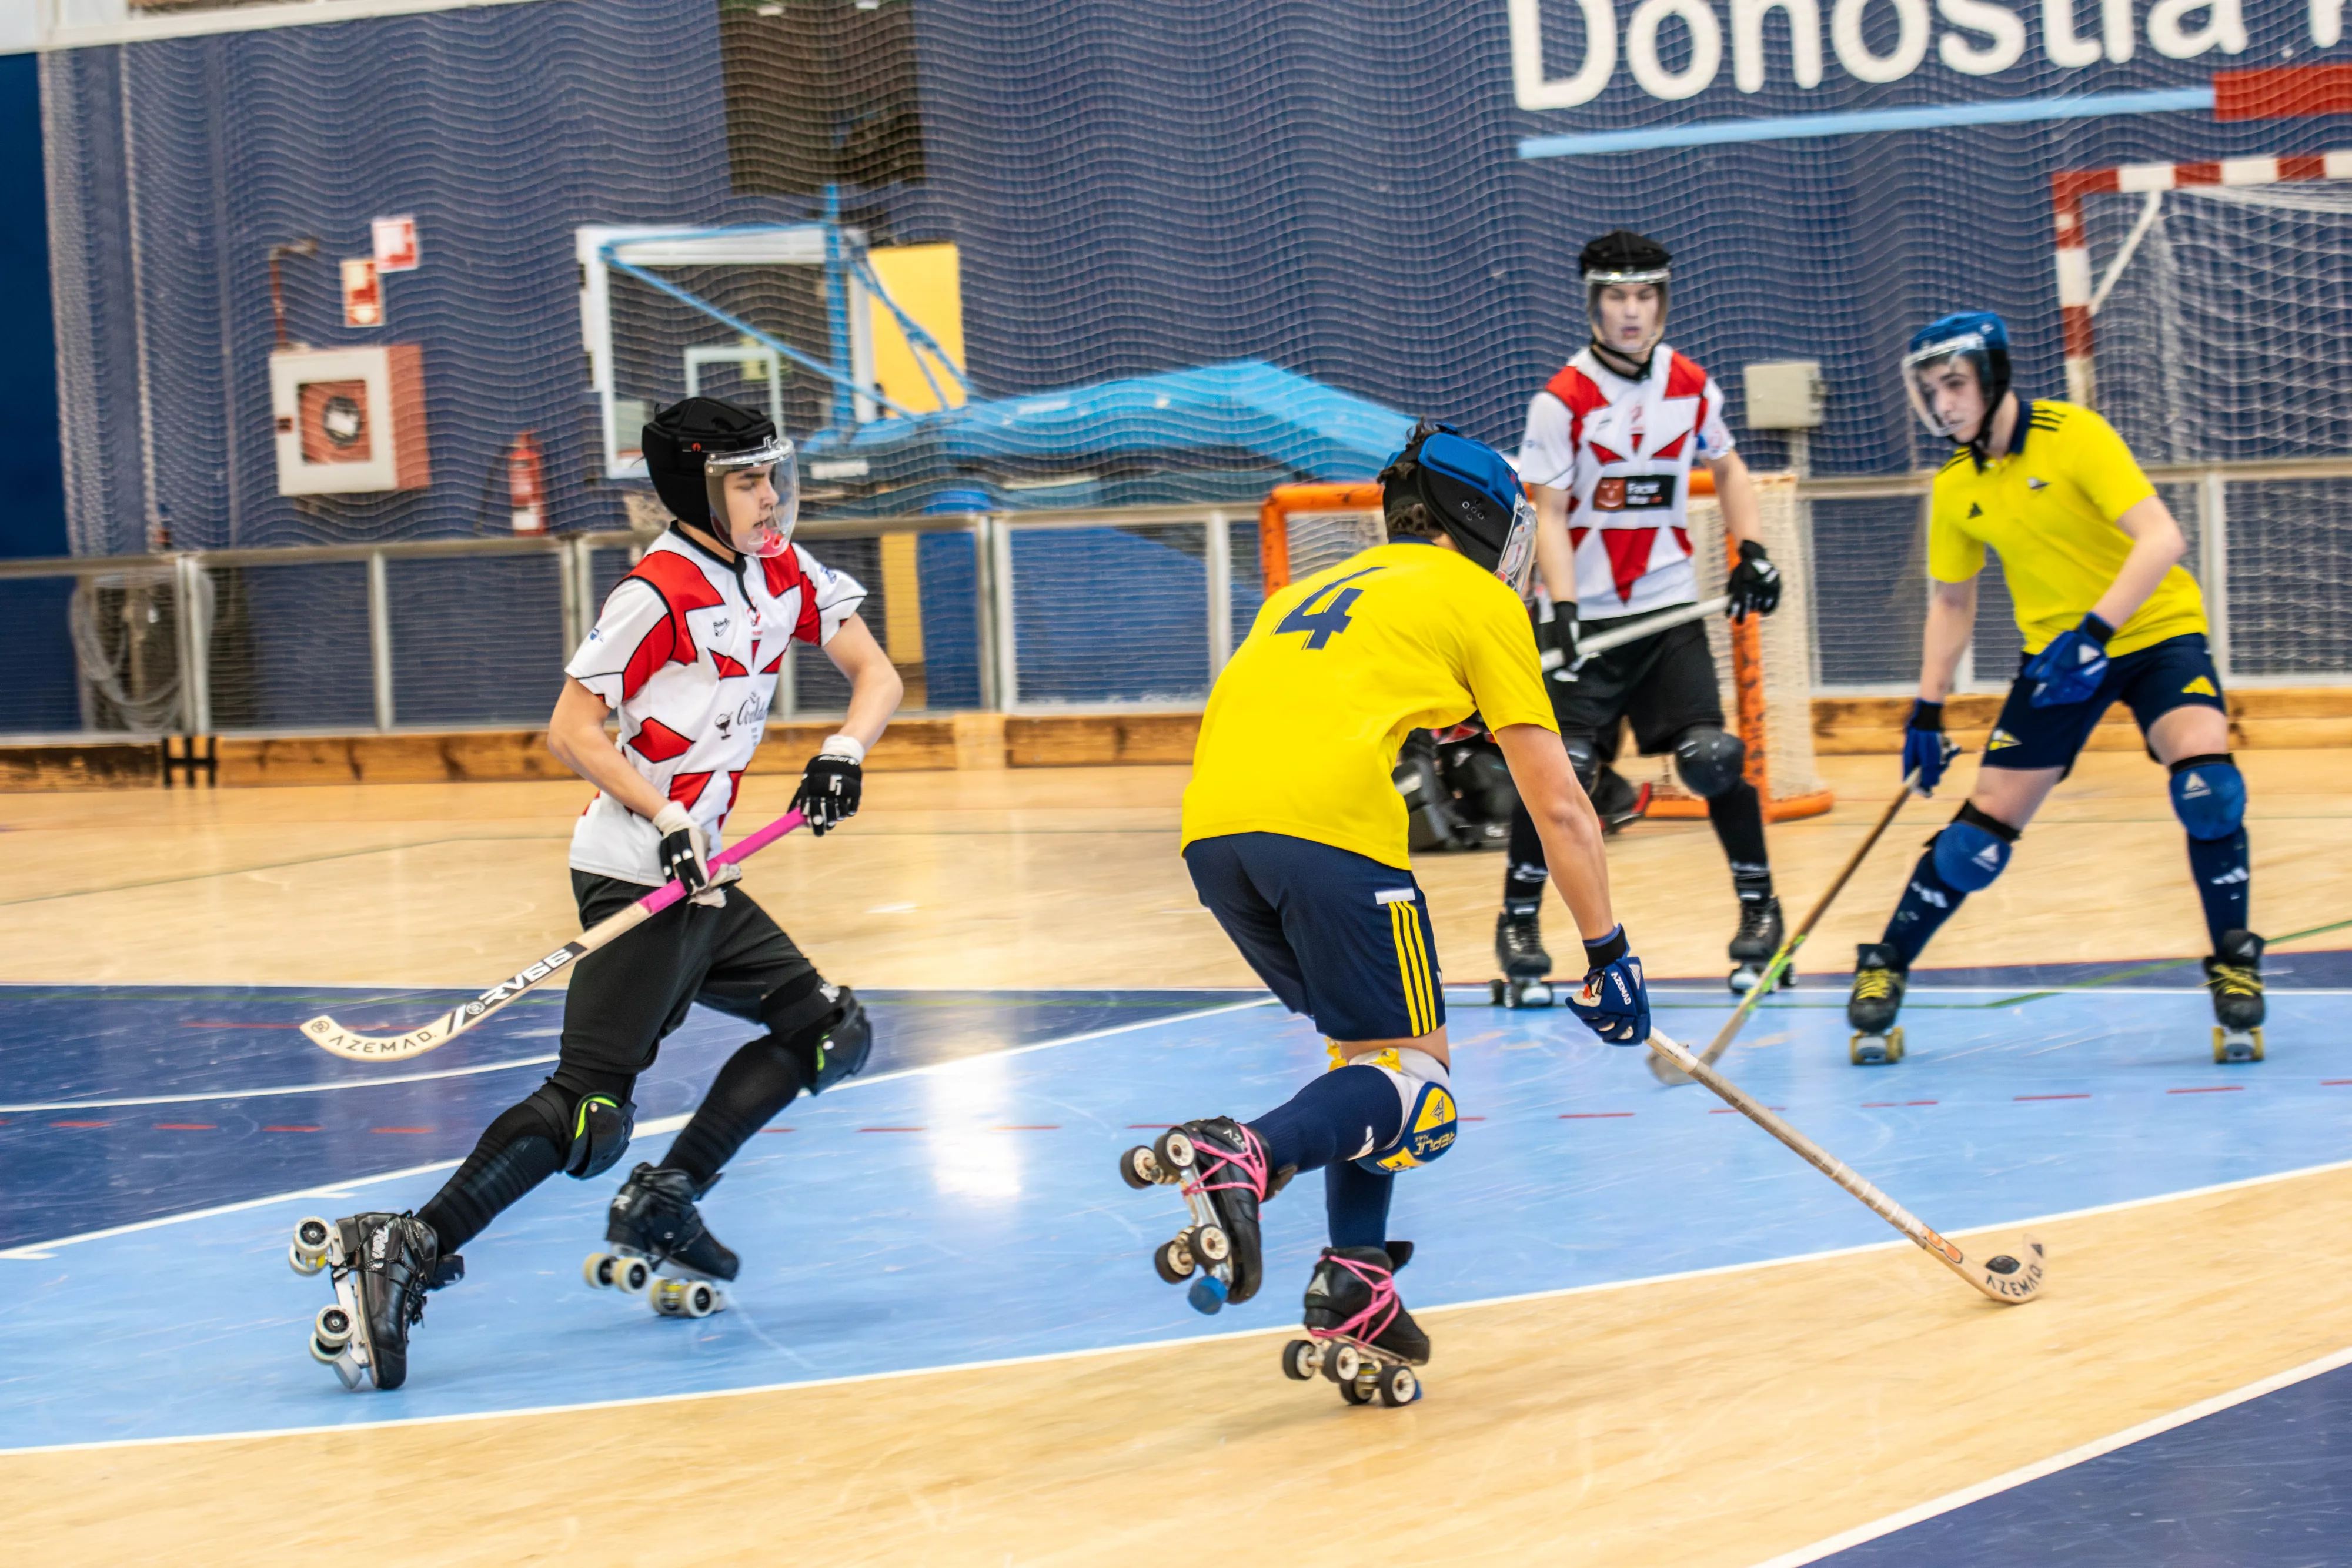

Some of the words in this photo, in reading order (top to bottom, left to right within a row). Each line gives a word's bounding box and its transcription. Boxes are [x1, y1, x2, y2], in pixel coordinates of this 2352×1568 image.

[1270, 566, 1388, 651] 4
[478, 947, 574, 1006] RV66
[1611, 971, 1632, 1006] AZEMAD
[328, 1031, 432, 1054] AZEMAD
[1986, 1264, 2043, 1297] AZEMAD
